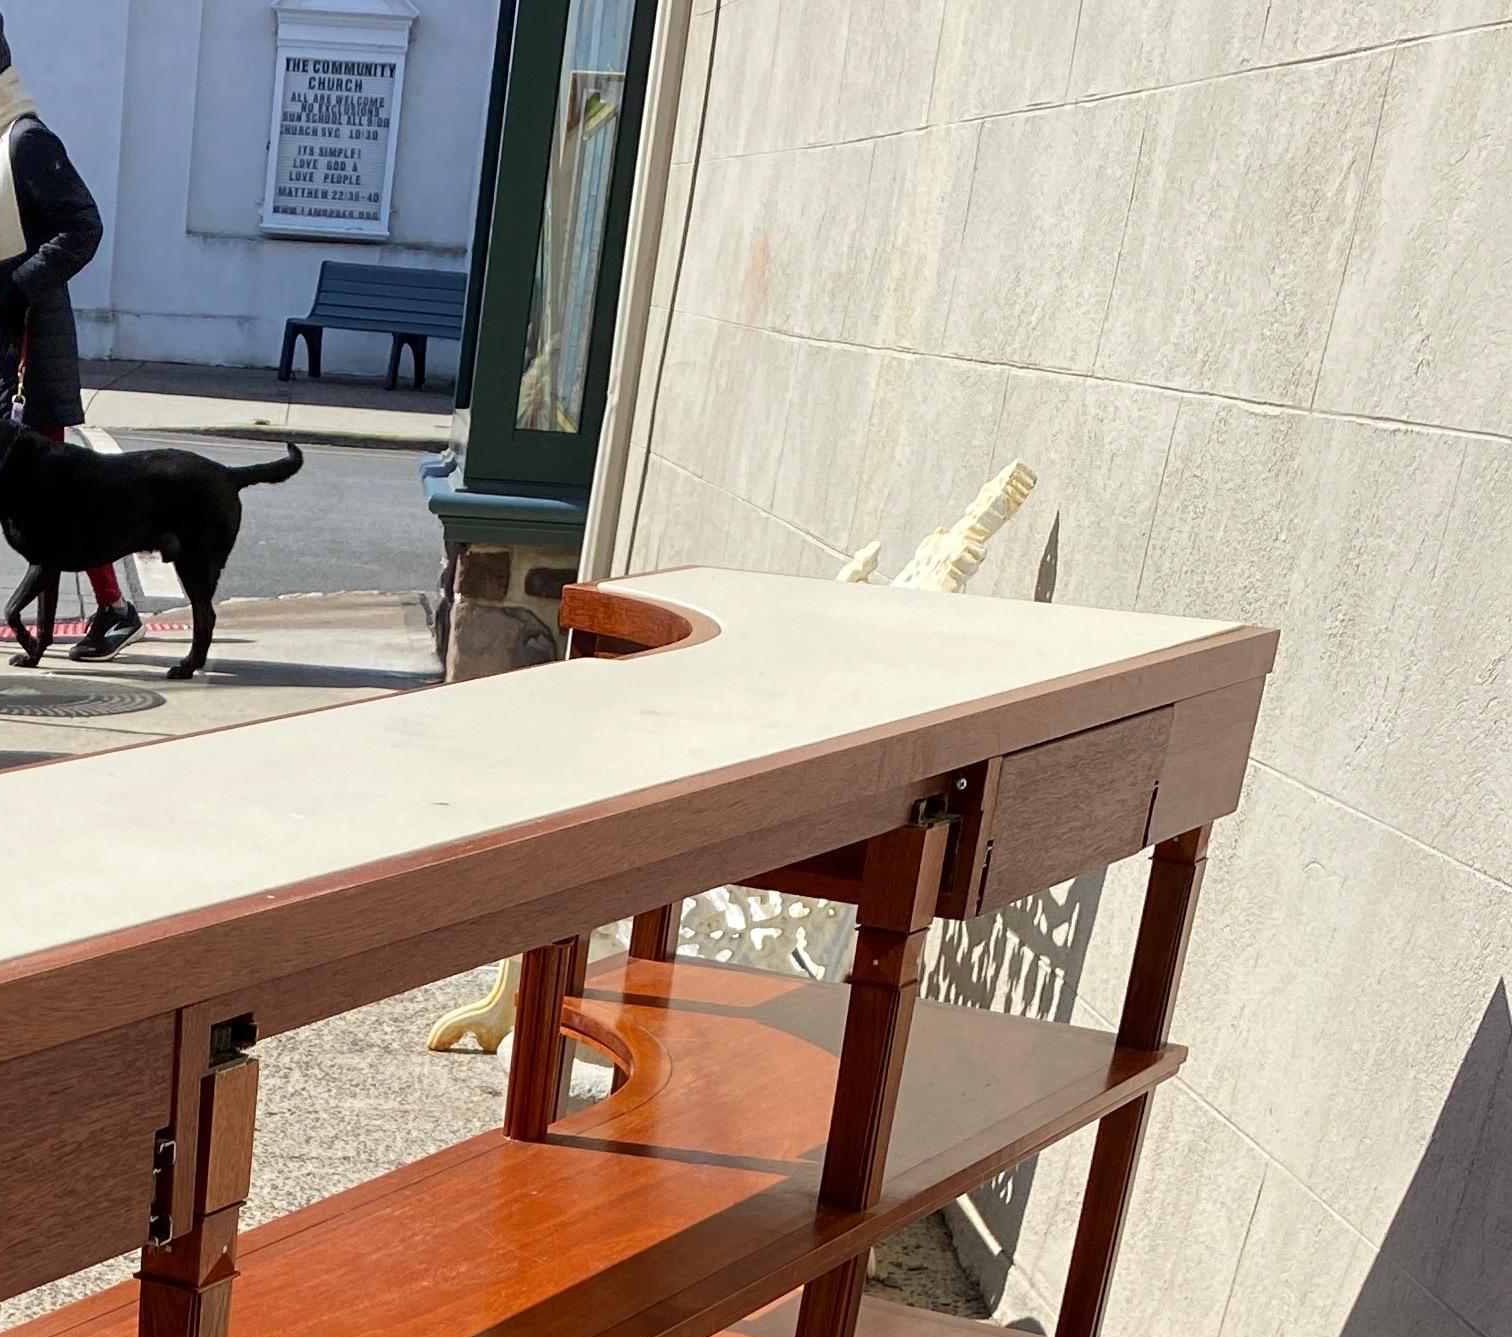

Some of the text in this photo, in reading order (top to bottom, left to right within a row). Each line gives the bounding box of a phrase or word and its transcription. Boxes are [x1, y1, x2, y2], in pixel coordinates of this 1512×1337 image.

[286, 58, 396, 78] THE COMMUNITY
[308, 77, 363, 93] CHURCH
[291, 91, 385, 108] ALL ARE WELCOME
[281, 111, 302, 122] SUN
[305, 112, 342, 125] SCHOOL
[301, 103, 380, 118] NO EXCLUSIONS
[280, 124, 318, 136] CHURCH
[321, 127, 340, 138] SVC
[293, 158, 318, 170] LOVE
[326, 160, 346, 171] GOD
[289, 170, 361, 185] LOVE PEOPLE
[278, 187, 328, 199] MATTHEW
